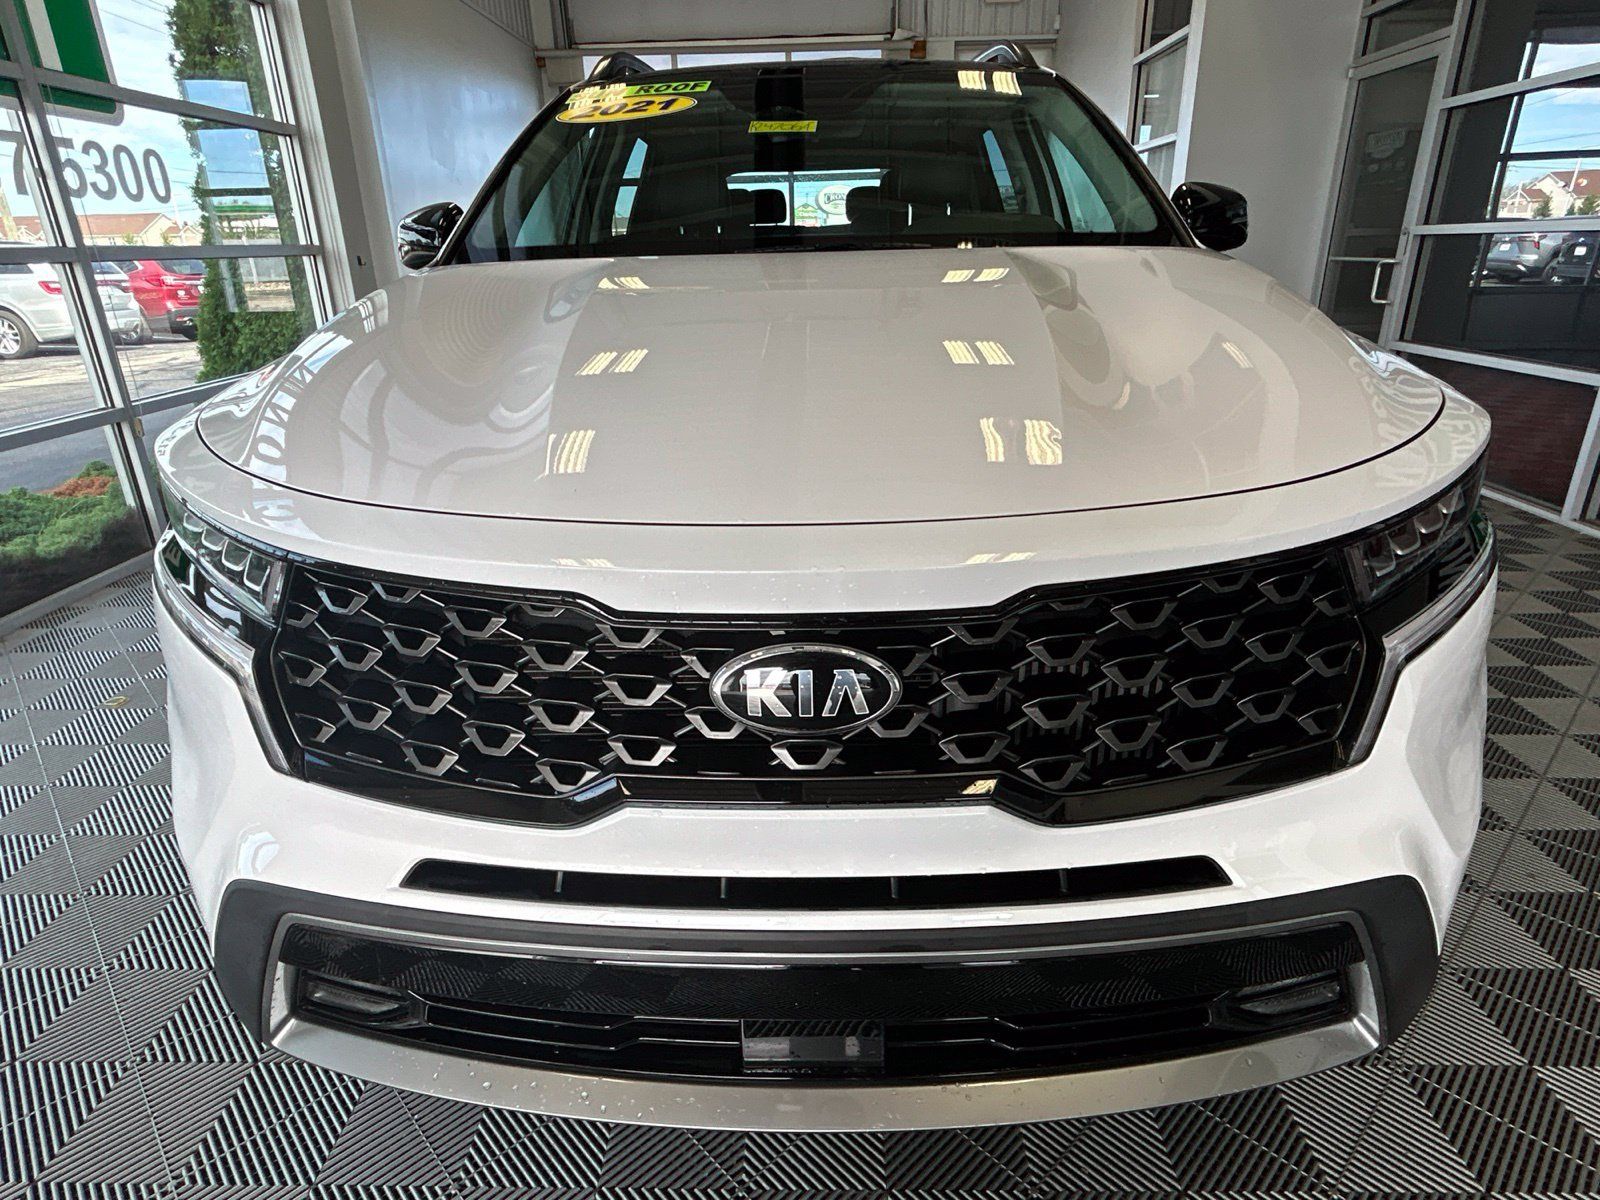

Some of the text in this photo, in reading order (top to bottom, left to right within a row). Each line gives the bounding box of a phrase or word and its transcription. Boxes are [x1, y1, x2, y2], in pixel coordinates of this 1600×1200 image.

[634, 81, 710, 95] ROOF
[568, 98, 680, 119] 2021
[743, 668, 870, 717] KIA
